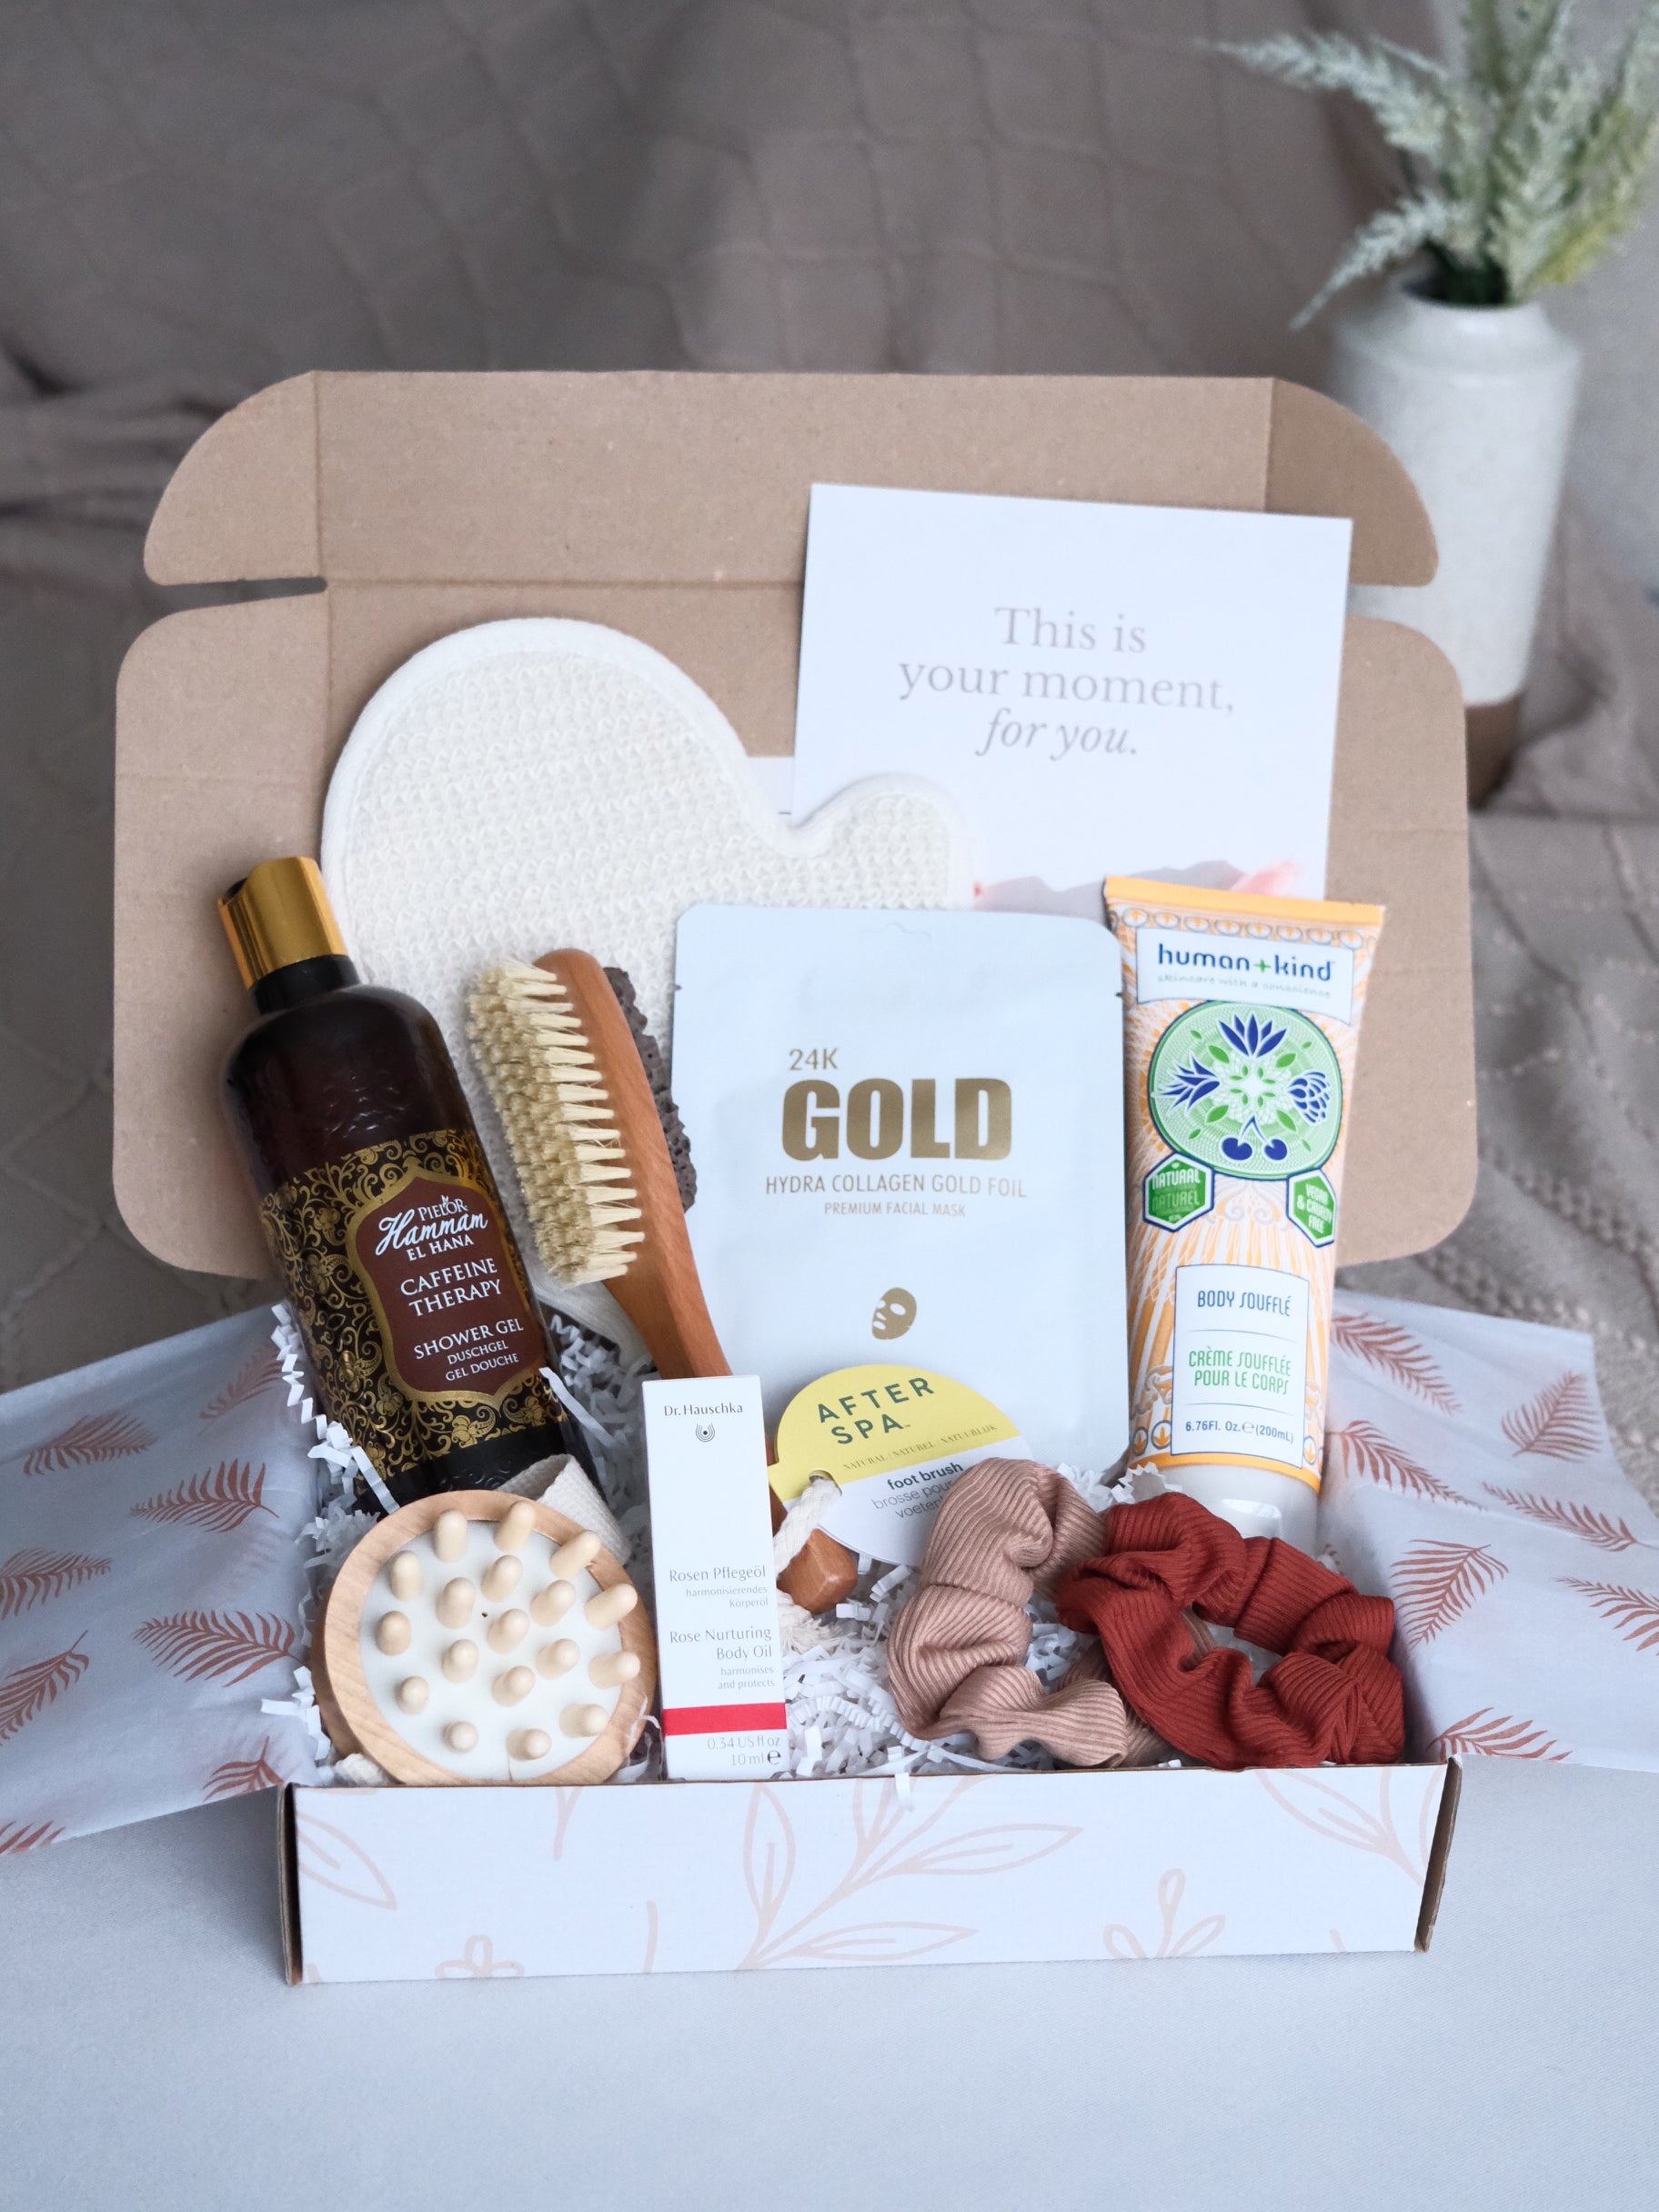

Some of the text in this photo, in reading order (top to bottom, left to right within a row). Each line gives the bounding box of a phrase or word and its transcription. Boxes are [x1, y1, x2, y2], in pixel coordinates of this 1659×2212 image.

[994, 606, 1147, 653] This is
[899, 661, 1233, 717] your moment,
[974, 708, 1138, 761] for you.
[789, 1048, 839, 1071] 24K
[781, 1078, 1012, 1161] GOLD
[766, 1173, 1026, 1198] HYDRA COLLAGEN GOLD FOIL
[1152, 1168, 1200, 1190] NATURAL
[824, 1202, 966, 1218] PREMIUM FACIAL MASK
[375, 1209, 488, 1256] Hammam
[407, 1234, 474, 1262] EL HANA
[400, 1258, 498, 1296] CAFFEINE
[408, 1279, 502, 1317] THERAPY
[1197, 1290, 1292, 1317] BODY SOUFFLÉ
[414, 1318, 524, 1360] SHOWER GEL
[447, 1340, 509, 1364] DUSCHGEL
[1189, 1346, 1292, 1377] CRÈME SOUFFLÉE
[446, 1352, 519, 1382] GEL DOUCHE
[1194, 1370, 1289, 1395] POUR LE CORPS
[664, 1402, 743, 1416] Dr. Hauschka
[818, 1376, 934, 1423] AFTER
[843, 1455, 888, 1470] NATURAL
[892, 1441, 935, 1457] NATUREL
[887, 1462, 963, 1491] foot brush
[871, 1490, 920, 1510] brosse
[669, 1565, 766, 1583] Rosen Pflegeöl
[686, 1585, 768, 1597] harmonisierendes
[669, 1626, 771, 1644] Rose Nurturing
[717, 1645, 772, 1663] Body Oil
[721, 1665, 774, 1675] harmonises
[718, 1678, 775, 1691] and protects
[707, 1735, 780, 1750] 0.34 US fl oz
[731, 1754, 747, 1766] 10
[749, 1752, 764, 1765] ml
